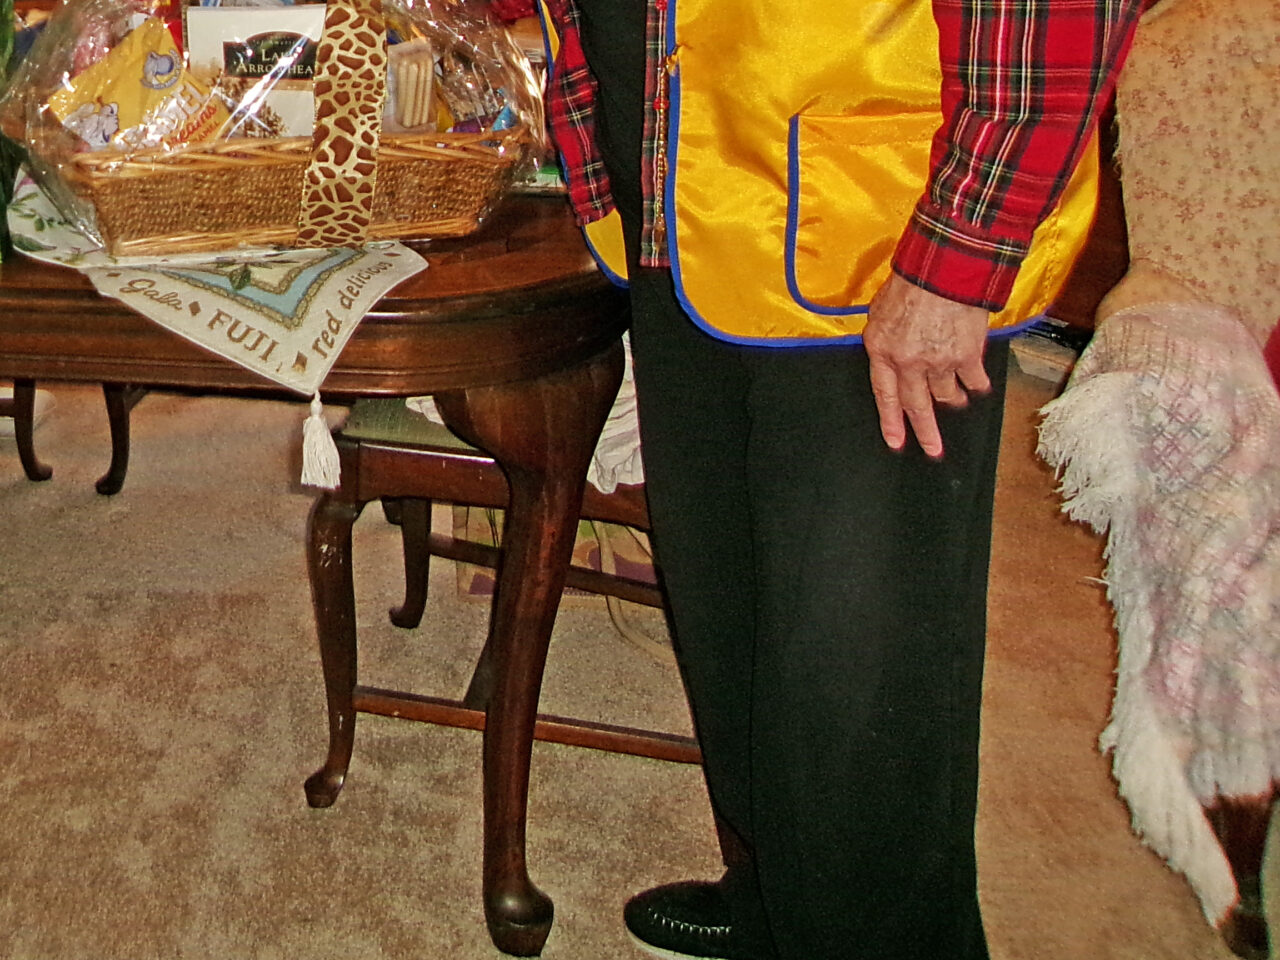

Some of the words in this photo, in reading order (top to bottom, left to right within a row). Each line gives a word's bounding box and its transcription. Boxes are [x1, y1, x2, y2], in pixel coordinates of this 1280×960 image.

[236, 62, 314, 76] ARROHEA
[119, 278, 183, 311] Gala
[207, 307, 280, 363] FUJI
[312, 309, 343, 360] red
[340, 260, 394, 311] delicious
